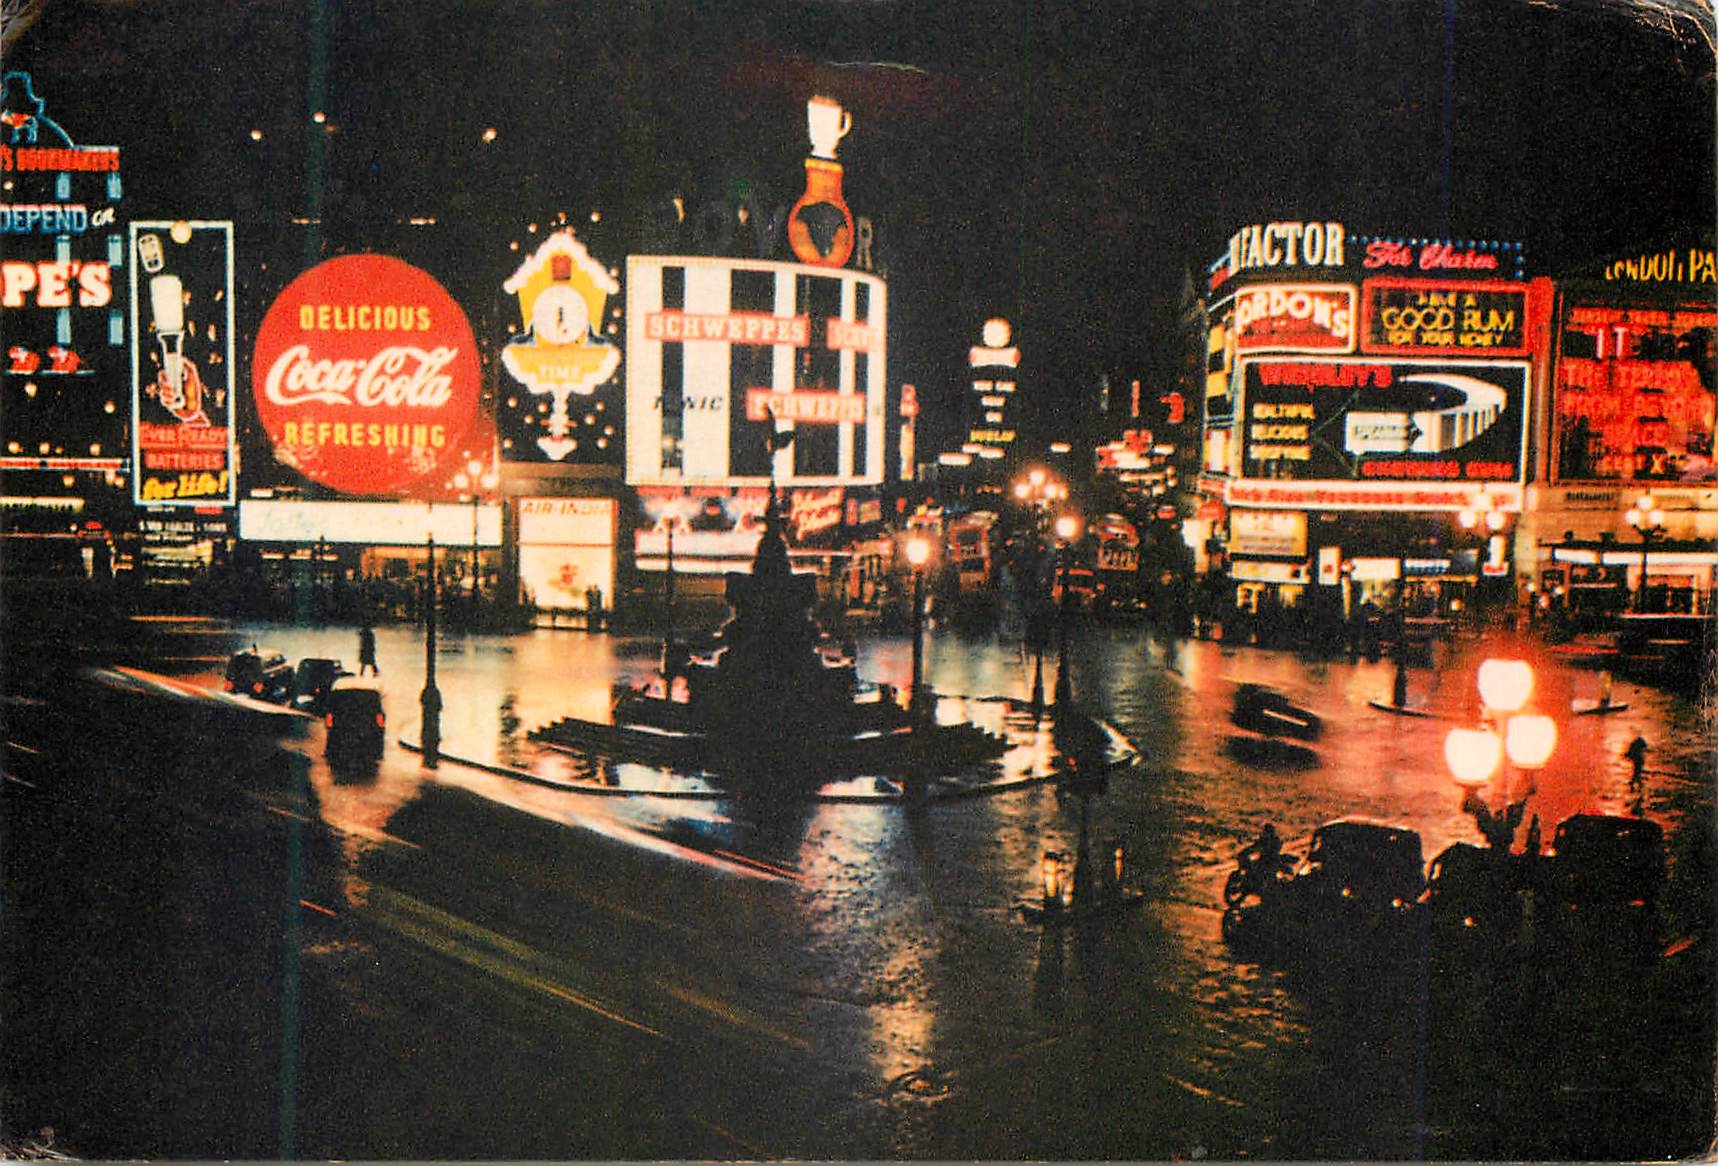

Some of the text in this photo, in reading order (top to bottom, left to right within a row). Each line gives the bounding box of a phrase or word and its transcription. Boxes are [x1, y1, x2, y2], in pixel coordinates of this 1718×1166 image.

[1240, 221, 1345, 269] FACTOR
[300, 304, 432, 332] DELICIOUS
[1235, 289, 1349, 338] ORDON'S
[1381, 306, 1515, 332] GOOD RUM
[649, 315, 807, 342] SCHWEPPES
[264, 344, 460, 407] Coca-Cola
[284, 420, 447, 449] REFRESHING
